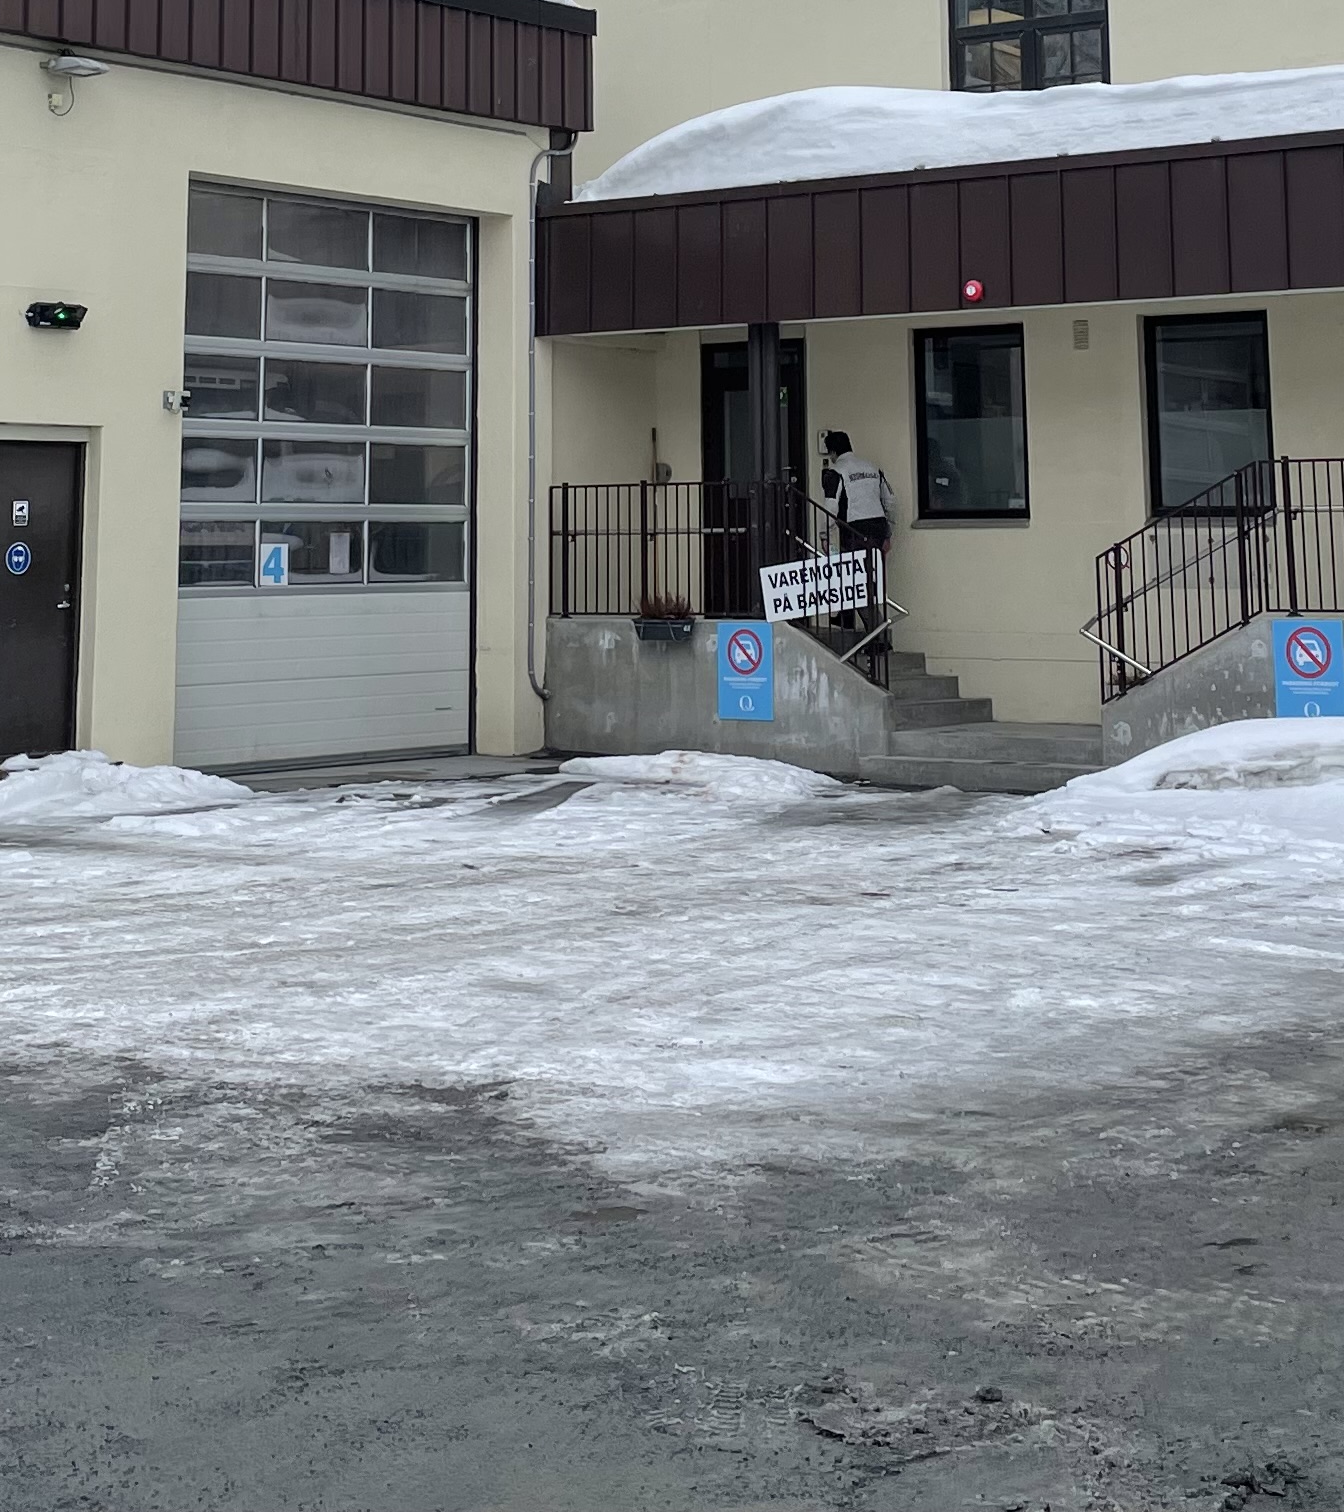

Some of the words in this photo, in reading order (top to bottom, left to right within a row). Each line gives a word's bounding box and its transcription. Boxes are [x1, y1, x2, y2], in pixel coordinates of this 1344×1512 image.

[262, 546, 285, 584] 4
[772, 592, 794, 614] PÅ
[796, 582, 875, 610] BAKSIDE
[739, 695, 755, 712] Q
